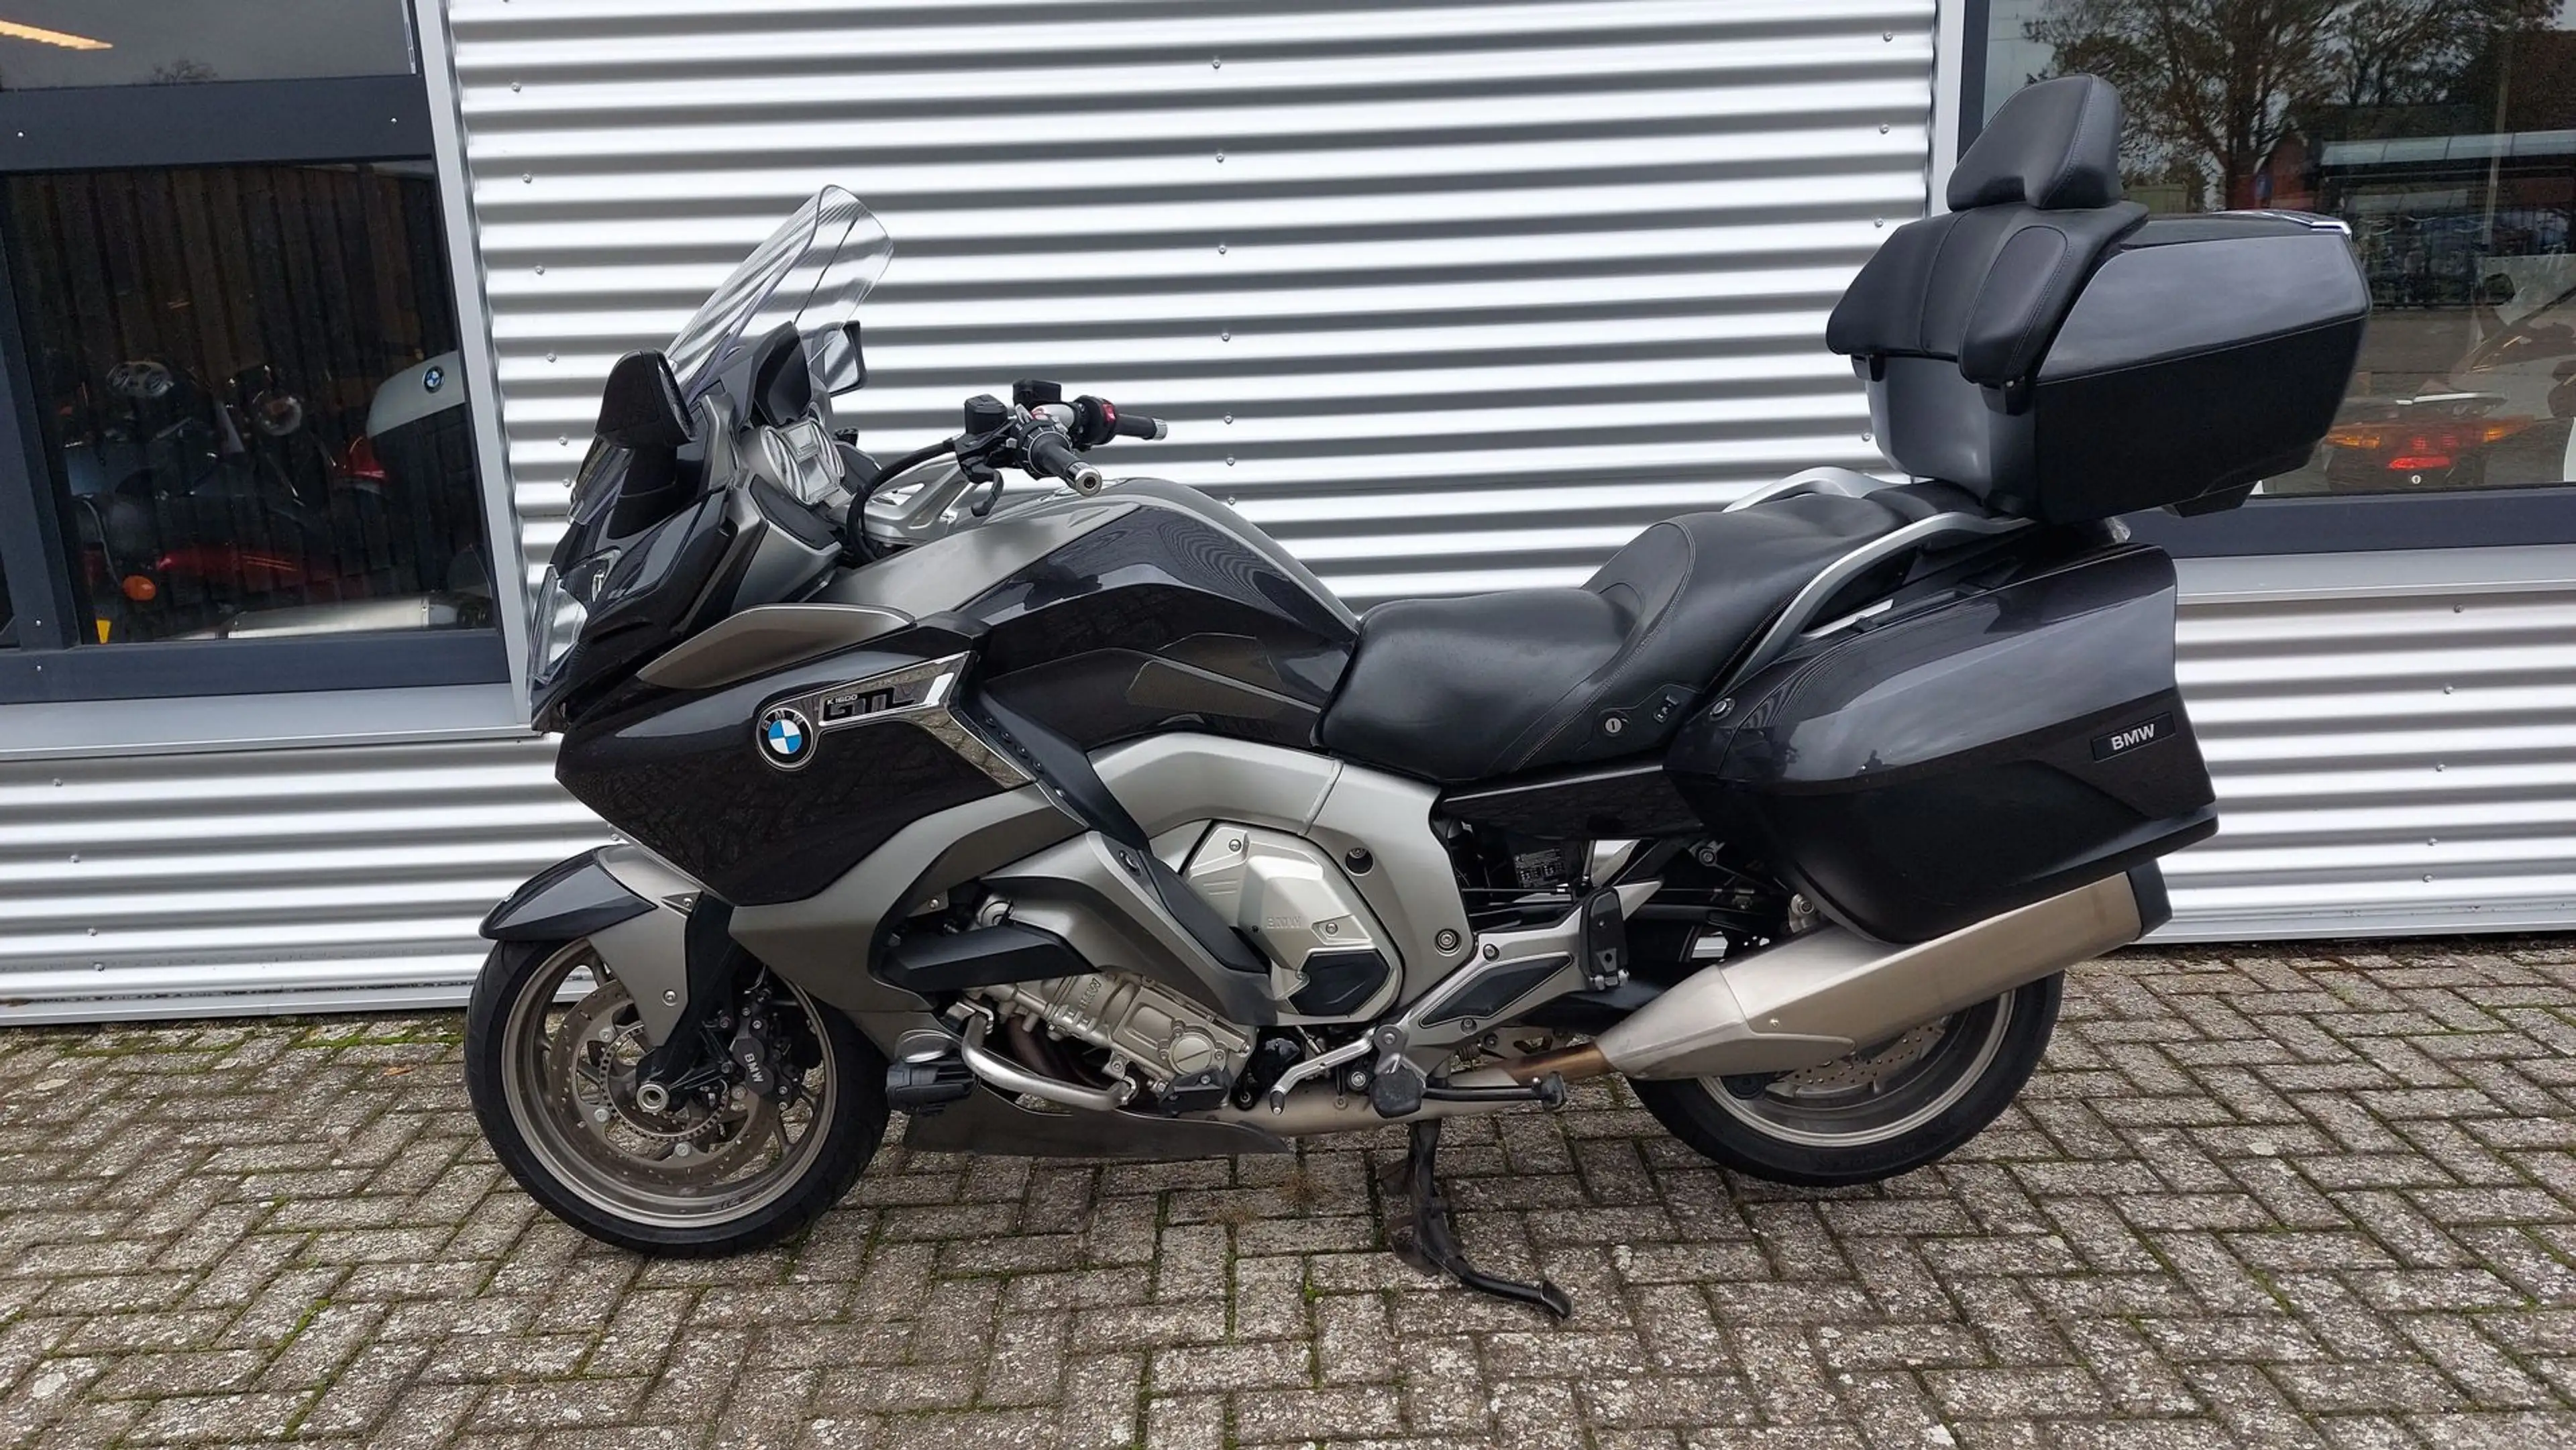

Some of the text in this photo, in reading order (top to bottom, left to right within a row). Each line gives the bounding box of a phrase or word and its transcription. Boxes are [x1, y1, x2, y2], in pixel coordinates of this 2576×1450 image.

[835, 693, 858, 703] 1600
[761, 710, 805, 731] BMW
[2110, 724, 2155, 750] BMW
[1267, 916, 1301, 930] BMW
[744, 1053, 763, 1082] BMW
